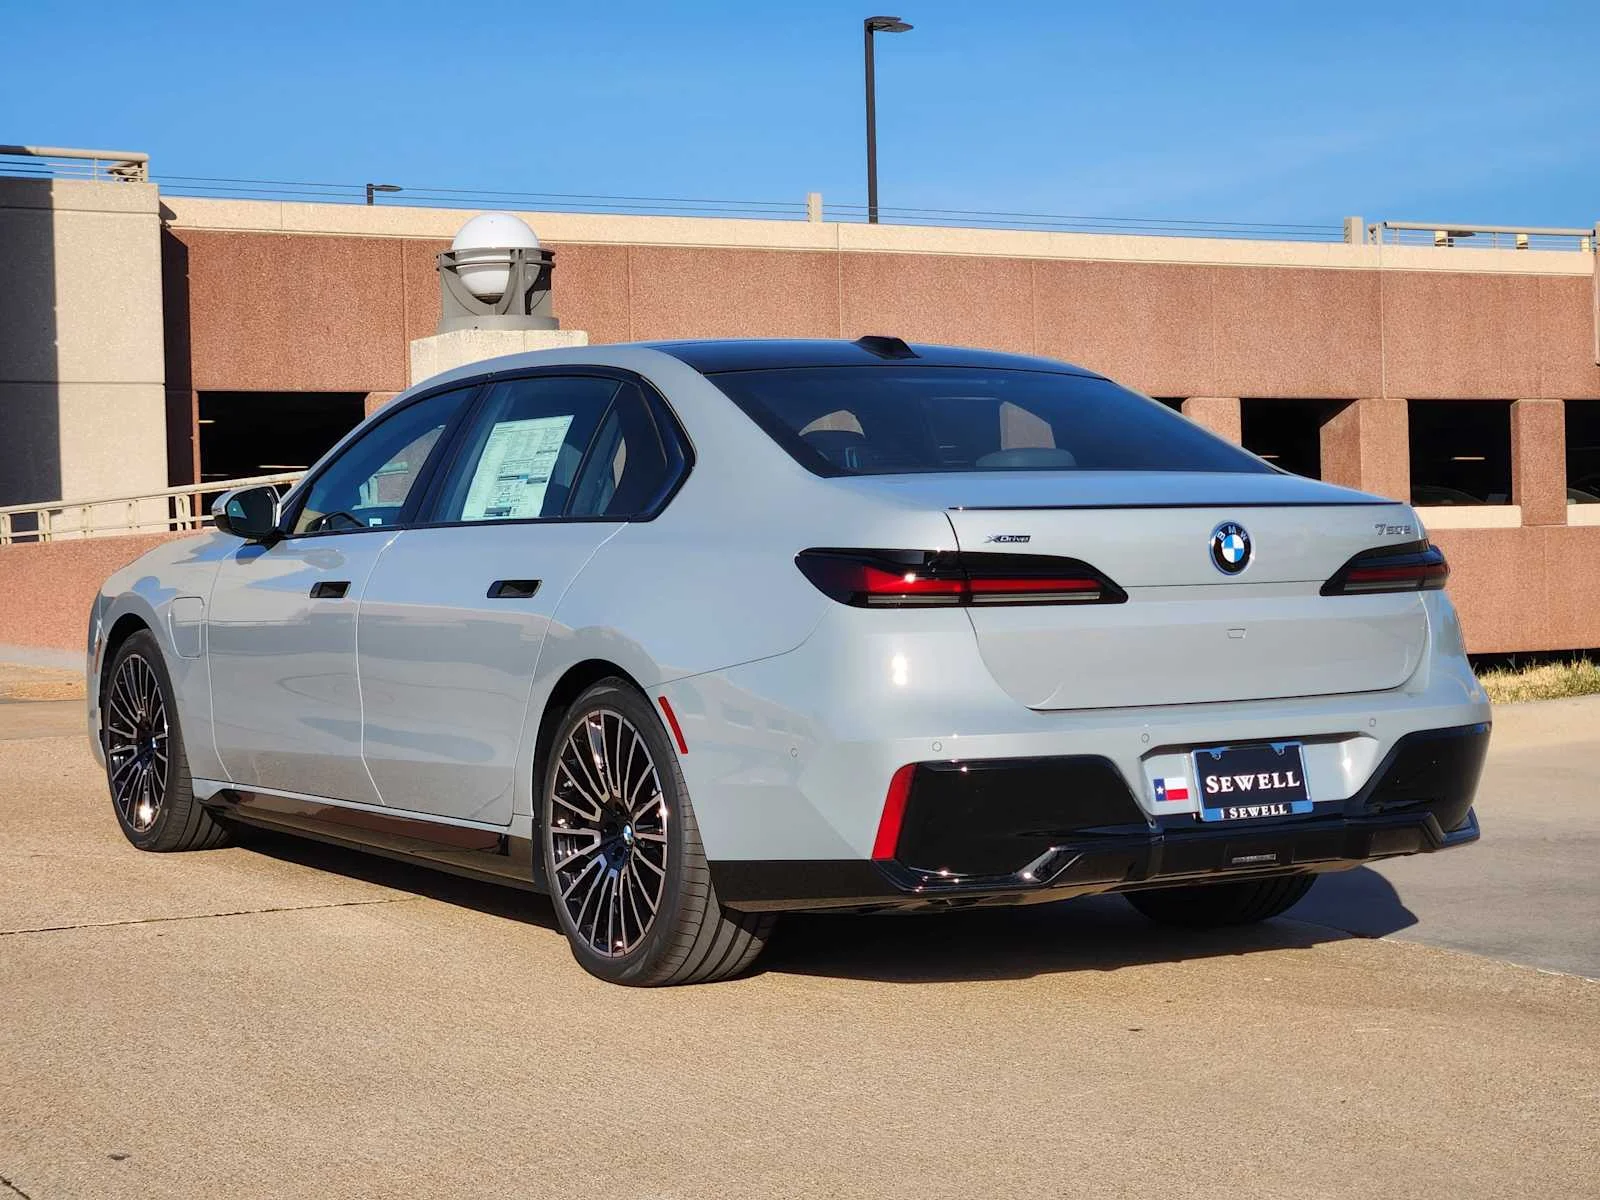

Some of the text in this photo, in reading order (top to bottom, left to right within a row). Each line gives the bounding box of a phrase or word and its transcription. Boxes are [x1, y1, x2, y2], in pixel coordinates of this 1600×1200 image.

[1216, 525, 1248, 541] BMW
[1206, 771, 1300, 793] SEWELL
[1229, 804, 1287, 819] SEWELL
